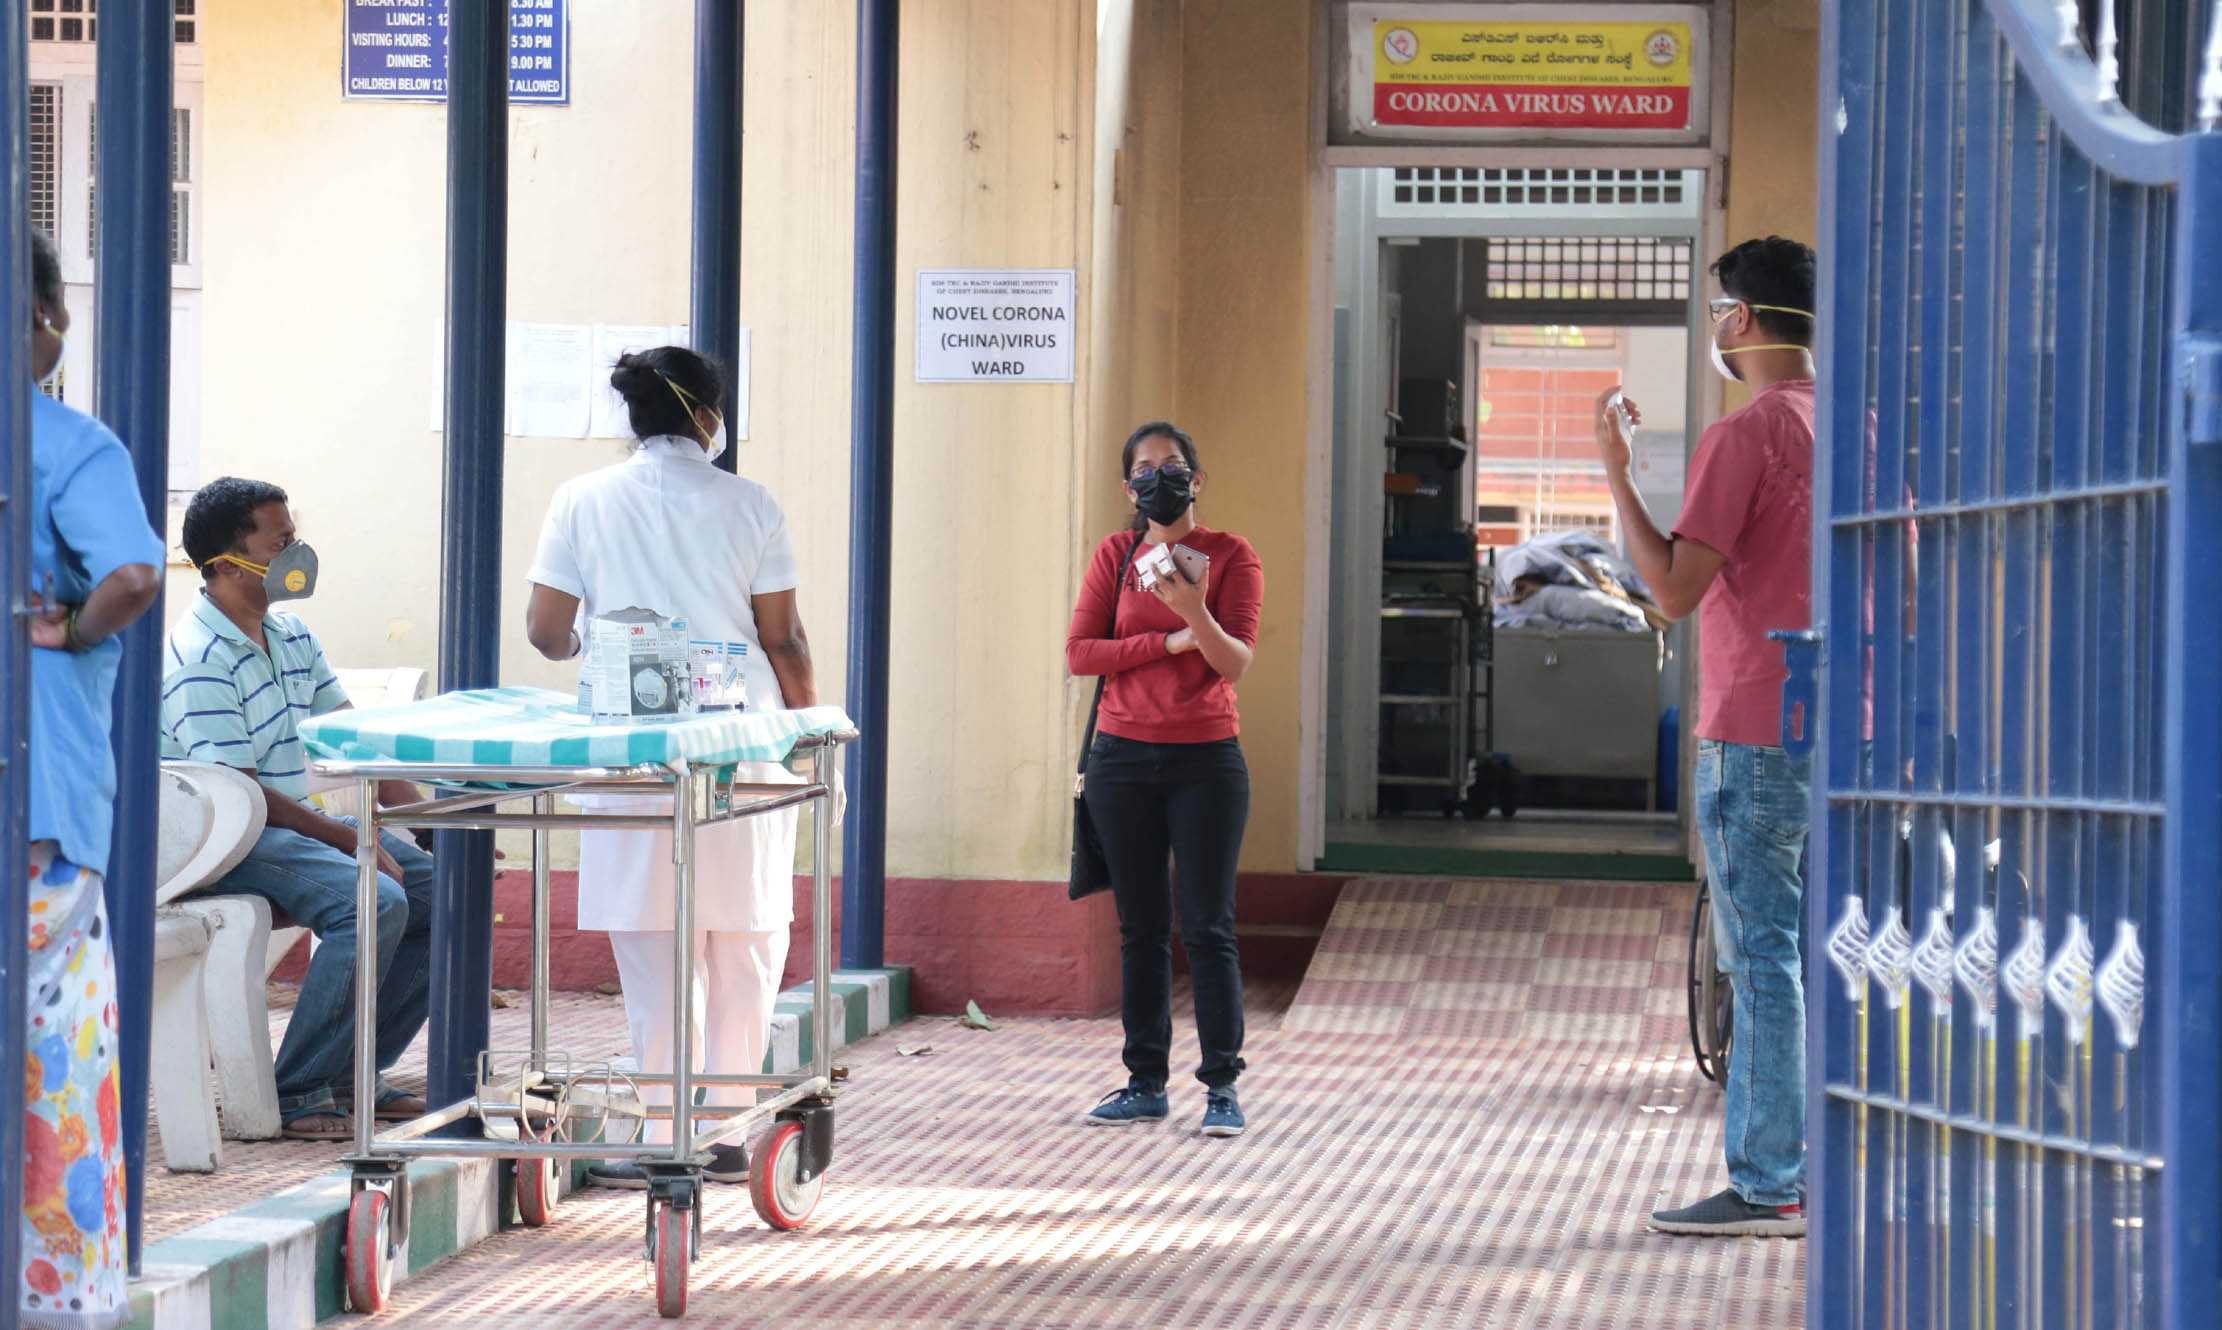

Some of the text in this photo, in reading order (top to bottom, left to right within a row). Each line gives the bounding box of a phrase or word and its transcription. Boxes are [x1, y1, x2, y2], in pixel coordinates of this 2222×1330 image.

[535, 0, 553, 9] AM
[386, 13, 425, 26] LUNCH
[511, 13, 533, 28] 1.30
[535, 13, 553, 28] PM
[352, 33, 393, 46] VISITING
[394, 33, 432, 47] HOURS:
[535, 34, 552, 48] PM
[386, 54, 432, 68] DINNER:
[510, 55, 533, 70] 9.00
[535, 55, 552, 70] PM
[351, 77, 396, 90] CHILDREN
[398, 78, 431, 90] BELOW
[432, 78, 443, 91] 12
[515, 79, 560, 92] ALLOWED
[1389, 92, 1674, 115] CORONA VIRUS WARD
[932, 307, 1066, 321] NOVEL CORONA
[941, 333, 1057, 350] (CHINA)VIRUS
[971, 361, 1025, 375] WARD
